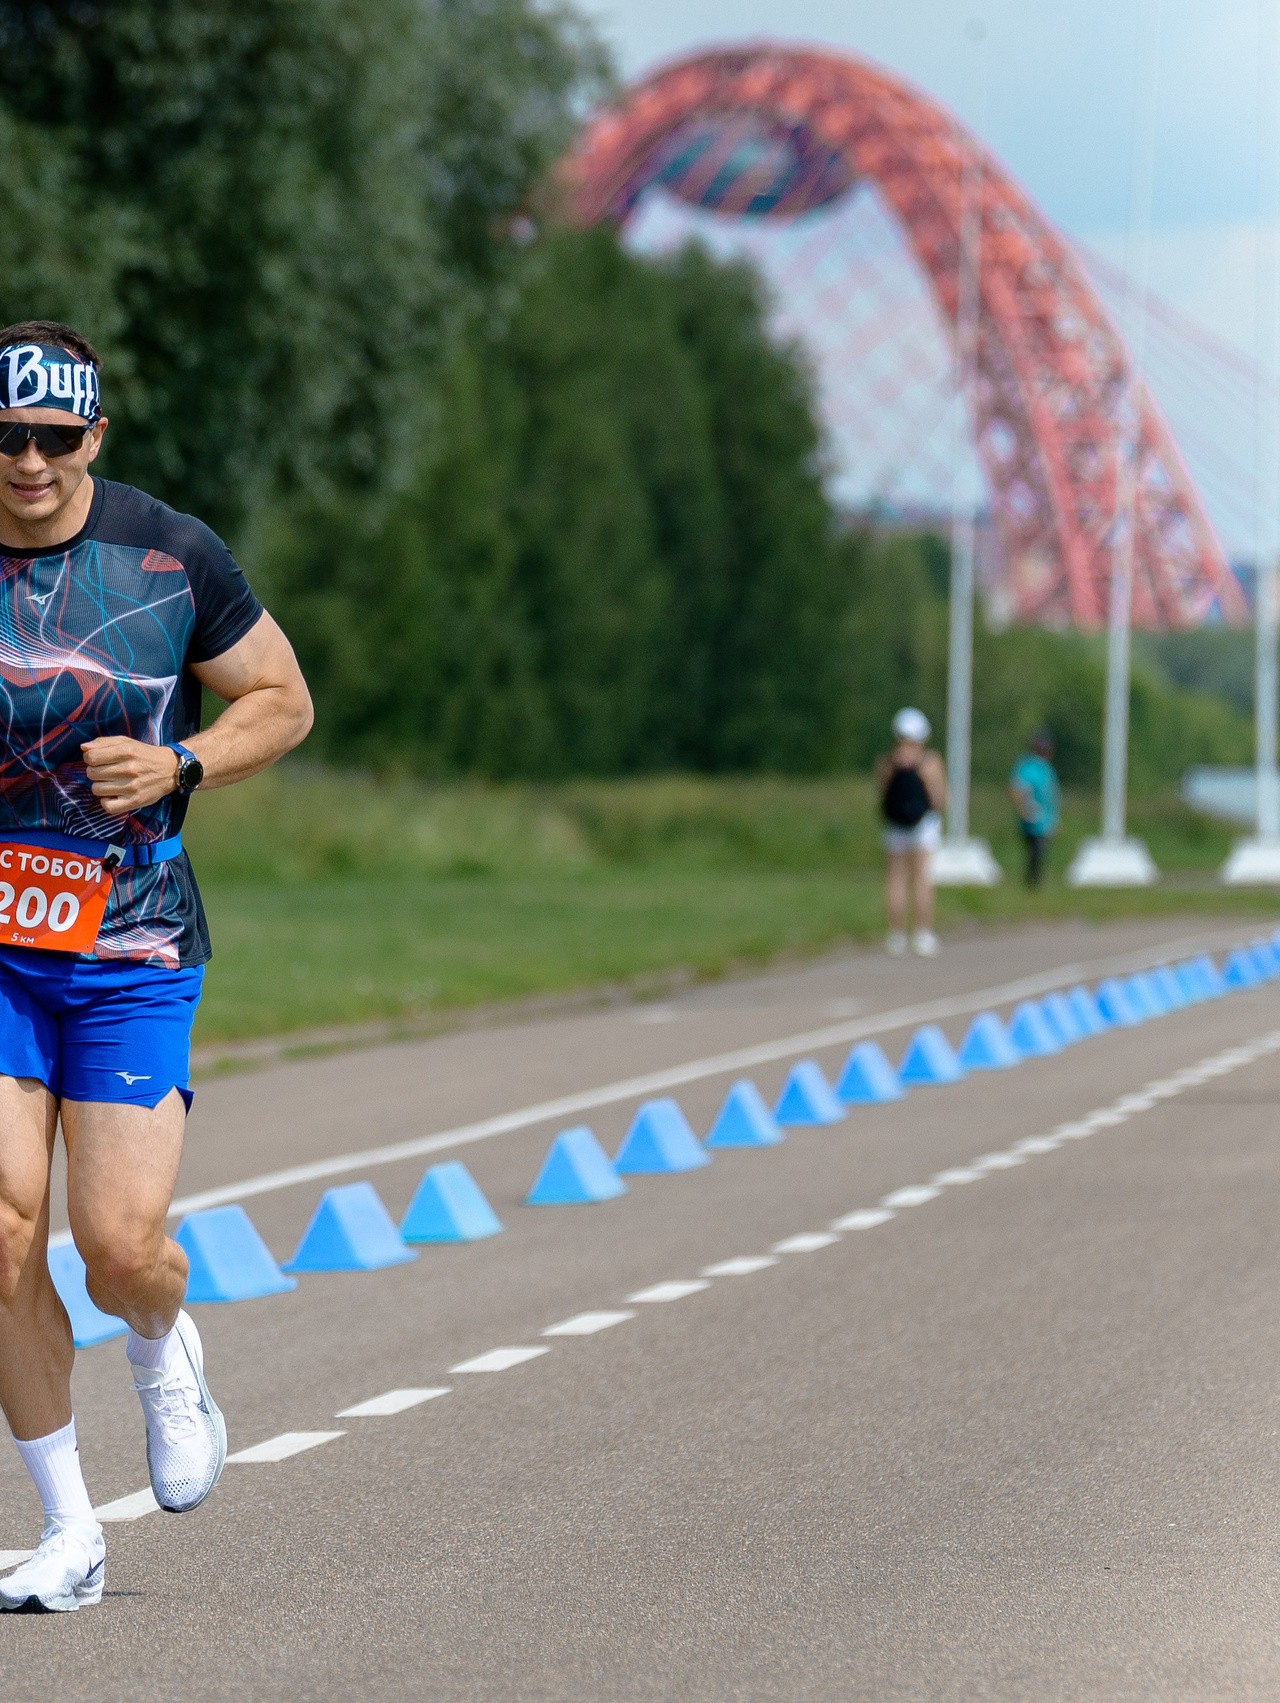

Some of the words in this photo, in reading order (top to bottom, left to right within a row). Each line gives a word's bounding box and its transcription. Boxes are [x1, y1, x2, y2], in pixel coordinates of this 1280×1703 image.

[0, 850, 13, 868] С
[18, 853, 102, 882] ТОБОЙ
[11, 932, 19, 942] 5
